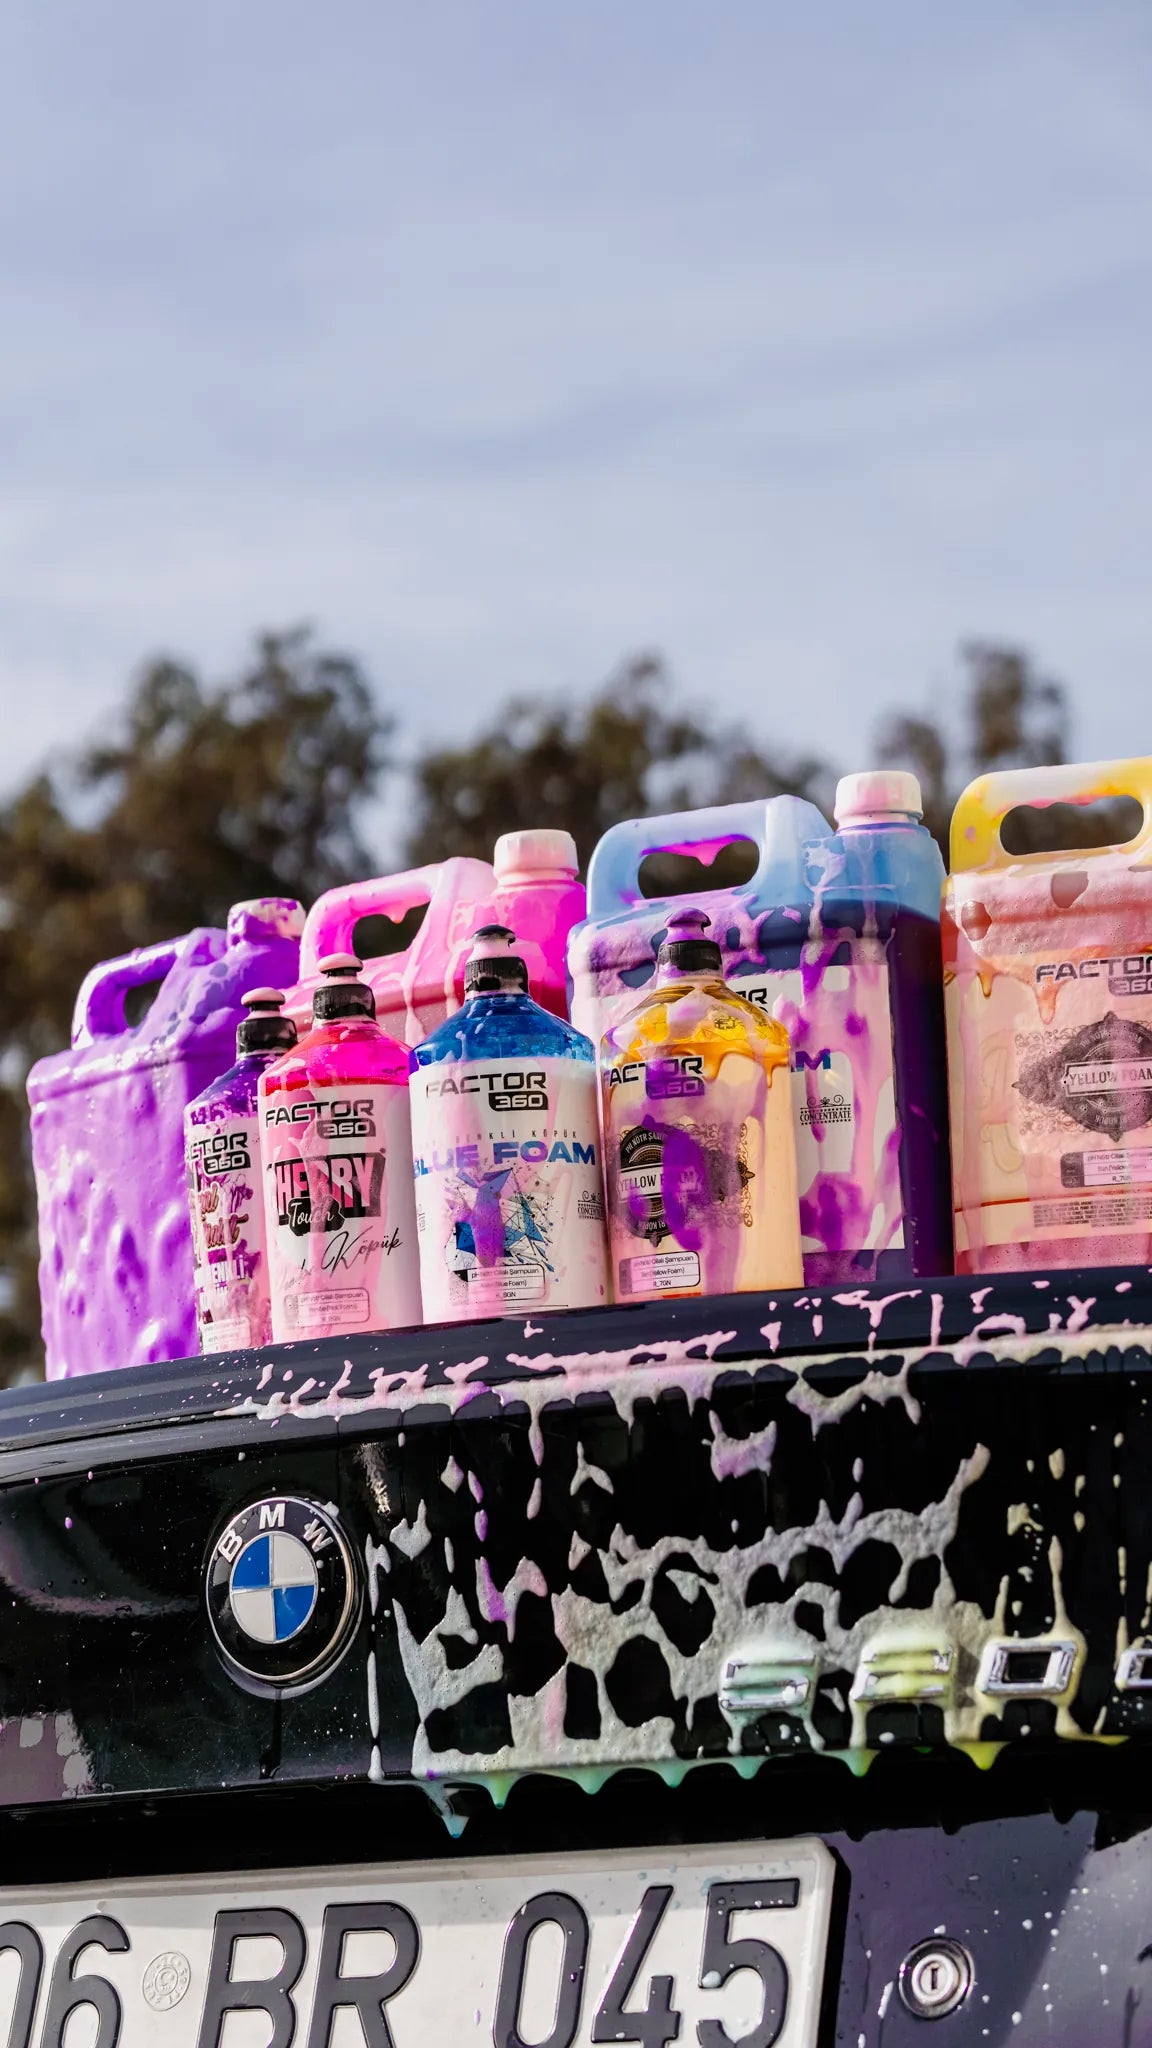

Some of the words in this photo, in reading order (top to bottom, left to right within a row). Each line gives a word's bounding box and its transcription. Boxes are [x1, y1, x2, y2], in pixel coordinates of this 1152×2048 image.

[1119, 978, 1152, 994] 36
[426, 1072, 547, 1098] FACTOR
[604, 1057, 703, 1087] ACTOR
[1069, 1070, 1116, 1086] YELLOW
[652, 1080, 699, 1096] 360
[265, 1099, 375, 1128] FACTOR
[495, 1094, 543, 1109] 360
[322, 1121, 371, 1137] 360
[800, 1110, 852, 1123] CONCENTRATE
[187, 1132, 248, 1160] CTOR
[206, 1153, 246, 1173] 360
[412, 1144, 480, 1179] BLUE
[493, 1140, 596, 1166] FOAM
[267, 1156, 376, 1216] HERRY
[621, 1174, 657, 1192] YELLOW
[290, 1201, 334, 1228] Touch
[320, 1225, 403, 1278] Köpük
[508, 1279, 527, 1287] Foam)
[218, 1503, 333, 1563] BMW
[197, 1901, 421, 2048] BR
[493, 1877, 800, 2048] 045
